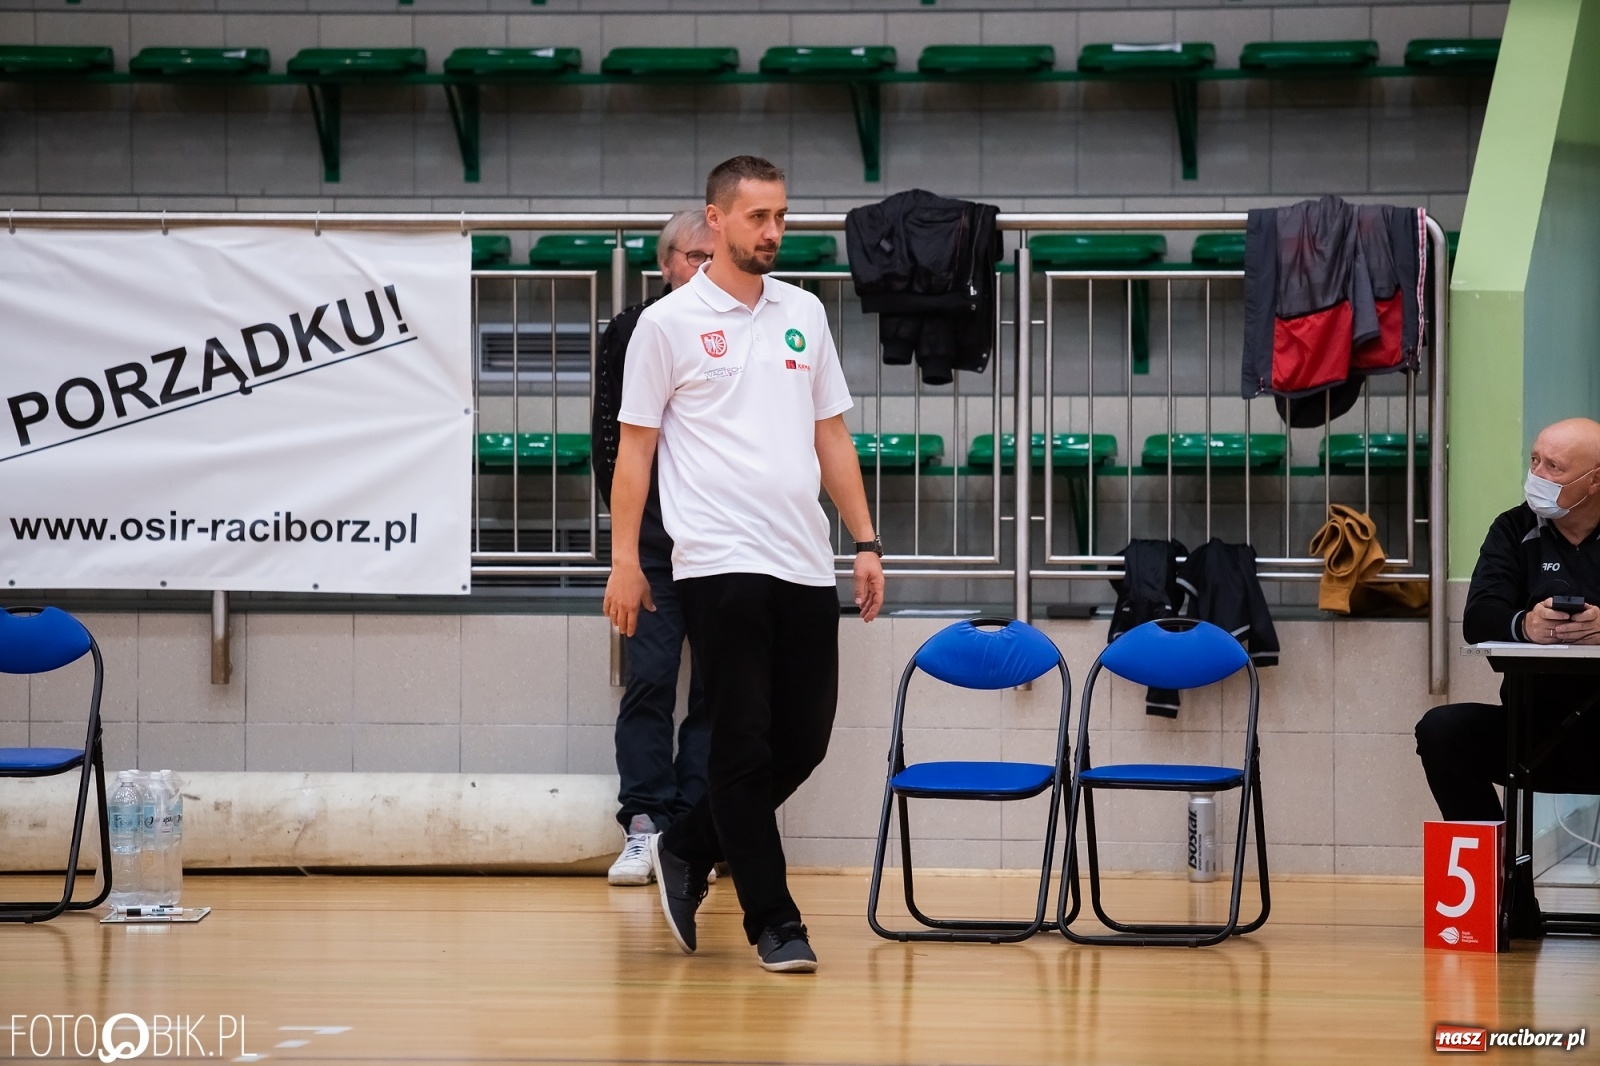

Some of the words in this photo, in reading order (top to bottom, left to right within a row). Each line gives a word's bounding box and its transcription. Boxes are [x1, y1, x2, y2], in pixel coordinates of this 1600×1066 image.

[7, 285, 409, 447] PORZĄDKU!
[10, 511, 418, 550] www.osir-raciborz.pl
[1435, 836, 1480, 918] 5
